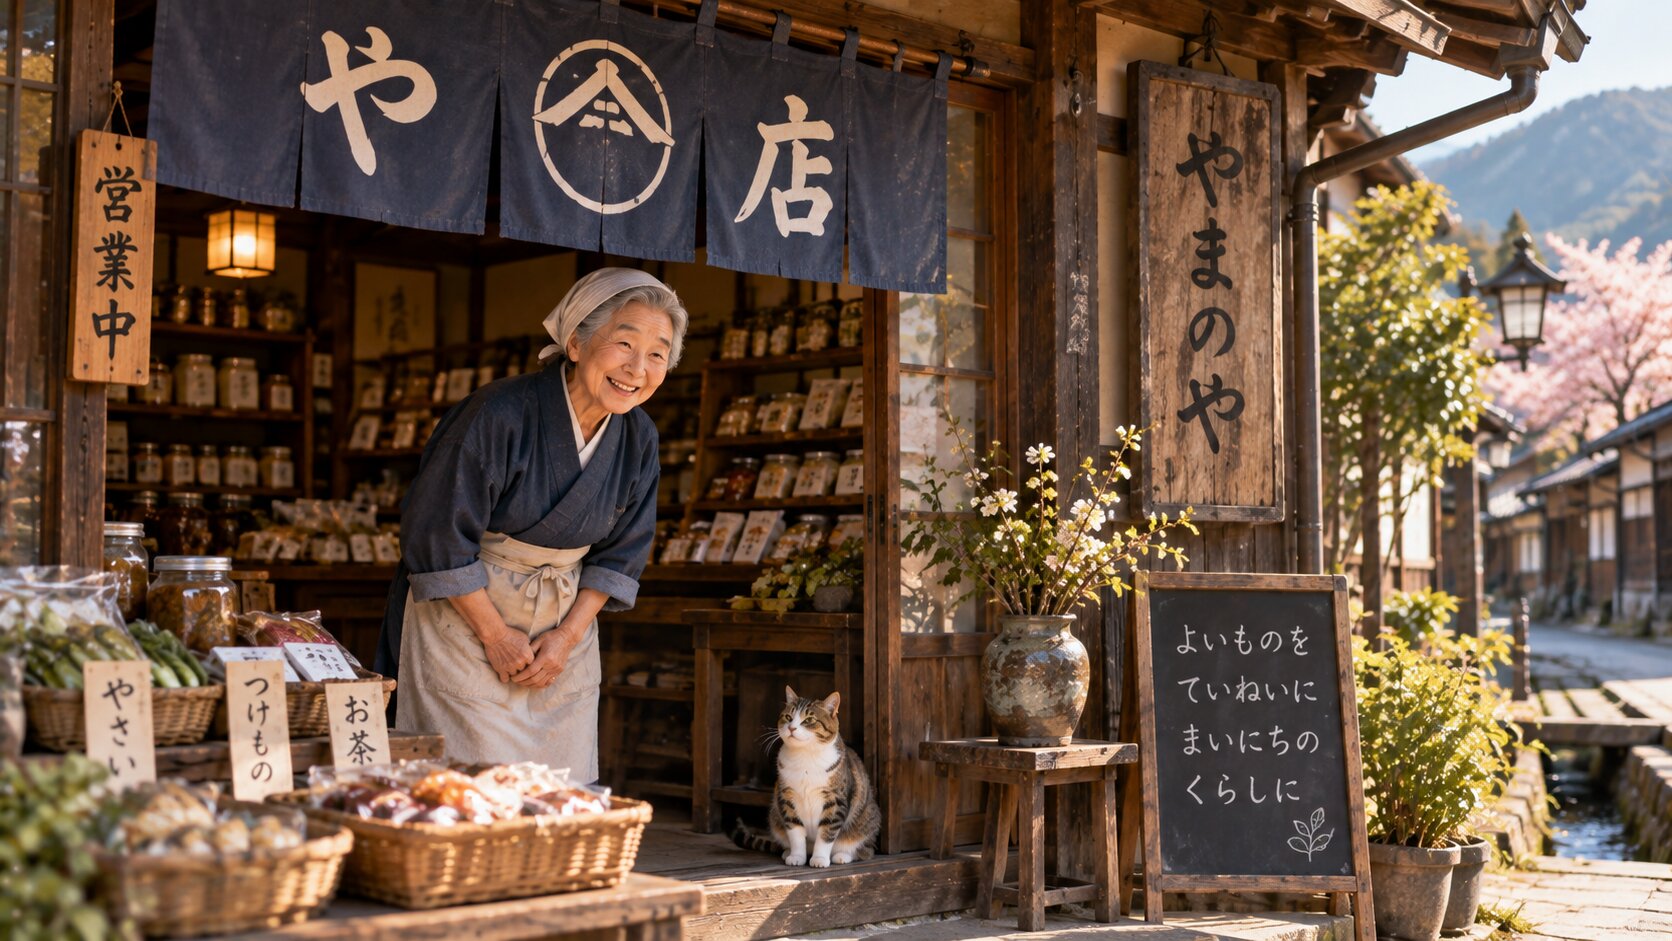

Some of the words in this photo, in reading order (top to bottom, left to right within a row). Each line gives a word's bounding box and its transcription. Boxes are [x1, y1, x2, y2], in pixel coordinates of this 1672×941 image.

[301, 26, 437, 176] や
[734, 94, 834, 238] 店
[92, 165, 142, 360] 営業中
[1176, 131, 1246, 455] やまのや
[1176, 624, 1309, 656] よいものを
[1177, 675, 1318, 703] ていねいに
[102, 678, 136, 776] やさい
[244, 677, 272, 782] つけもの
[345, 695, 377, 766] お茶
[1182, 723, 1320, 756] まいにちの
[1186, 773, 1300, 805] くらしに
